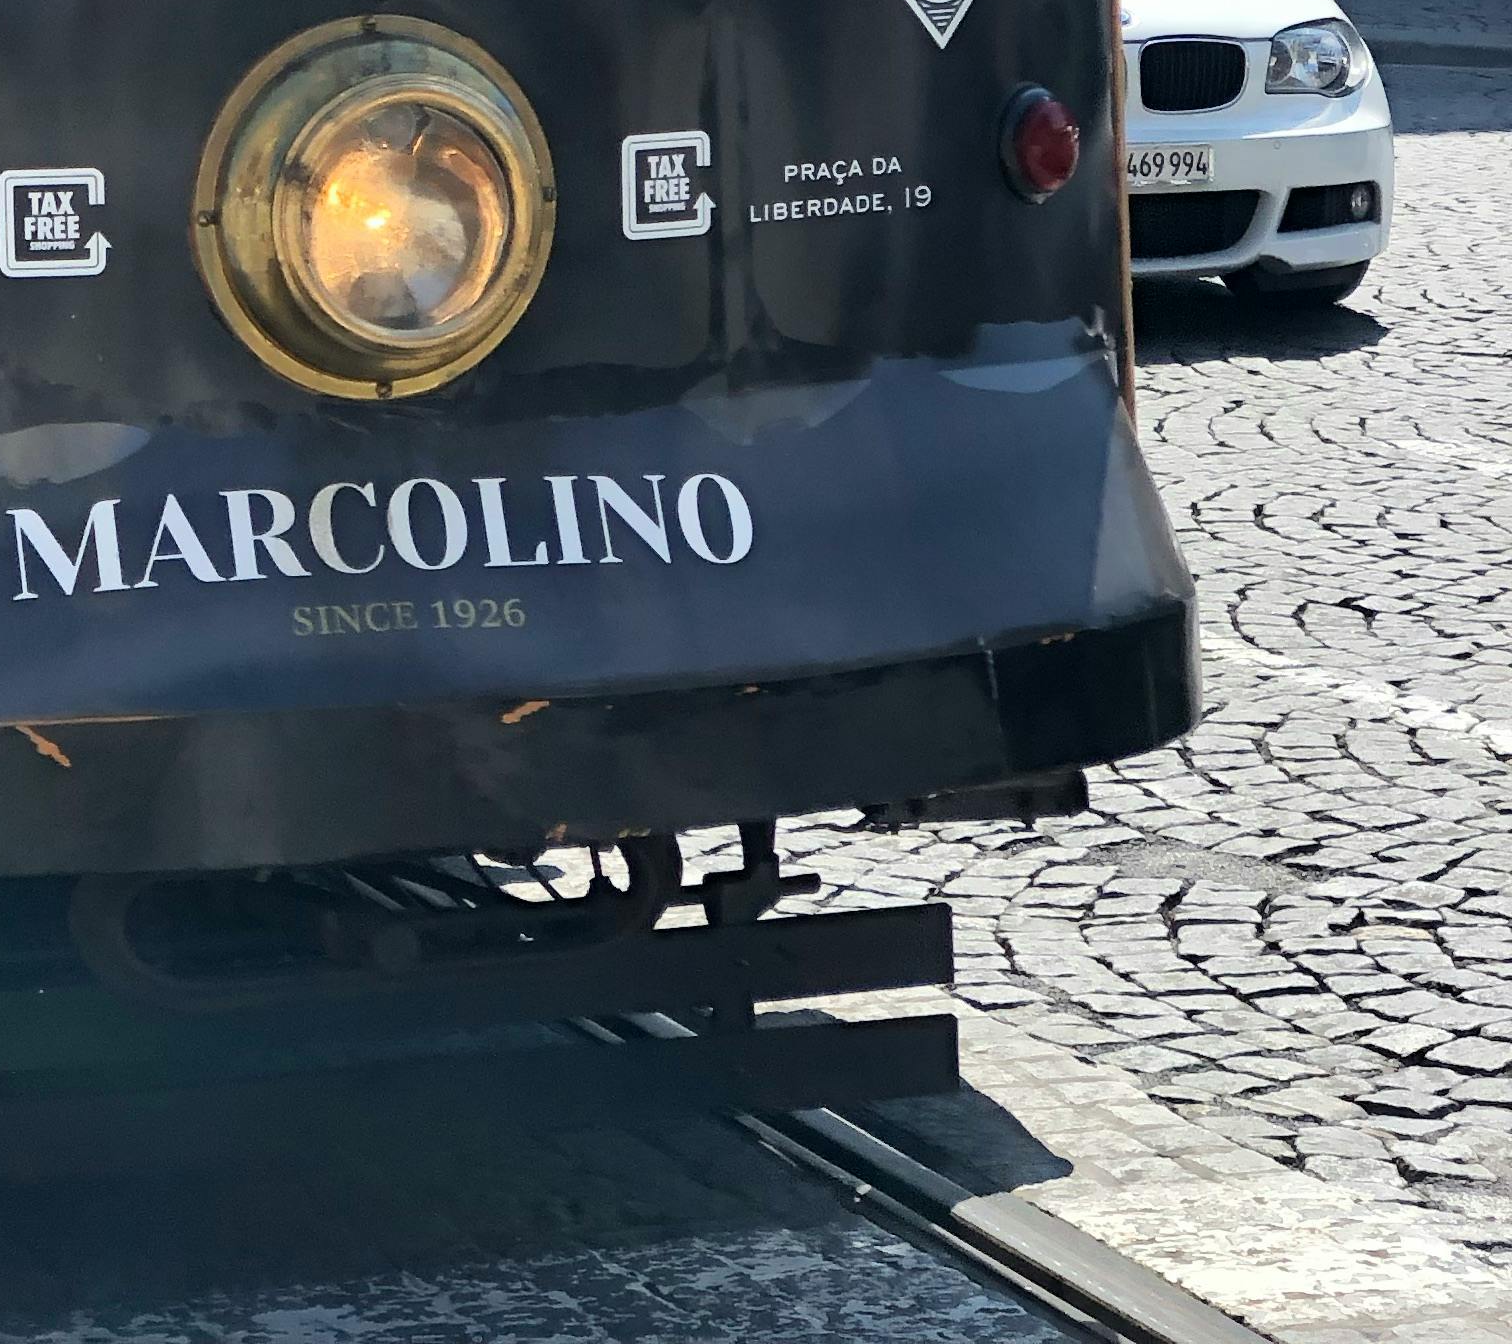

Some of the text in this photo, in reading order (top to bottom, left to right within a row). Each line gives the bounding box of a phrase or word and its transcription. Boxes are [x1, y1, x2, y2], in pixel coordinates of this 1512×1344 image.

[648, 154, 686, 179] TAX
[784, 156, 902, 185] PRAÇA DA
[1128, 152, 1207, 177] 469 994
[28, 191, 75, 216] TAX
[644, 178, 690, 204] FREE
[750, 185, 932, 223] LIBERDADE, 19
[24, 216, 80, 240] FREE
[5, 472, 754, 601] MARCOLINO
[292, 598, 527, 636] SINCE 1926
